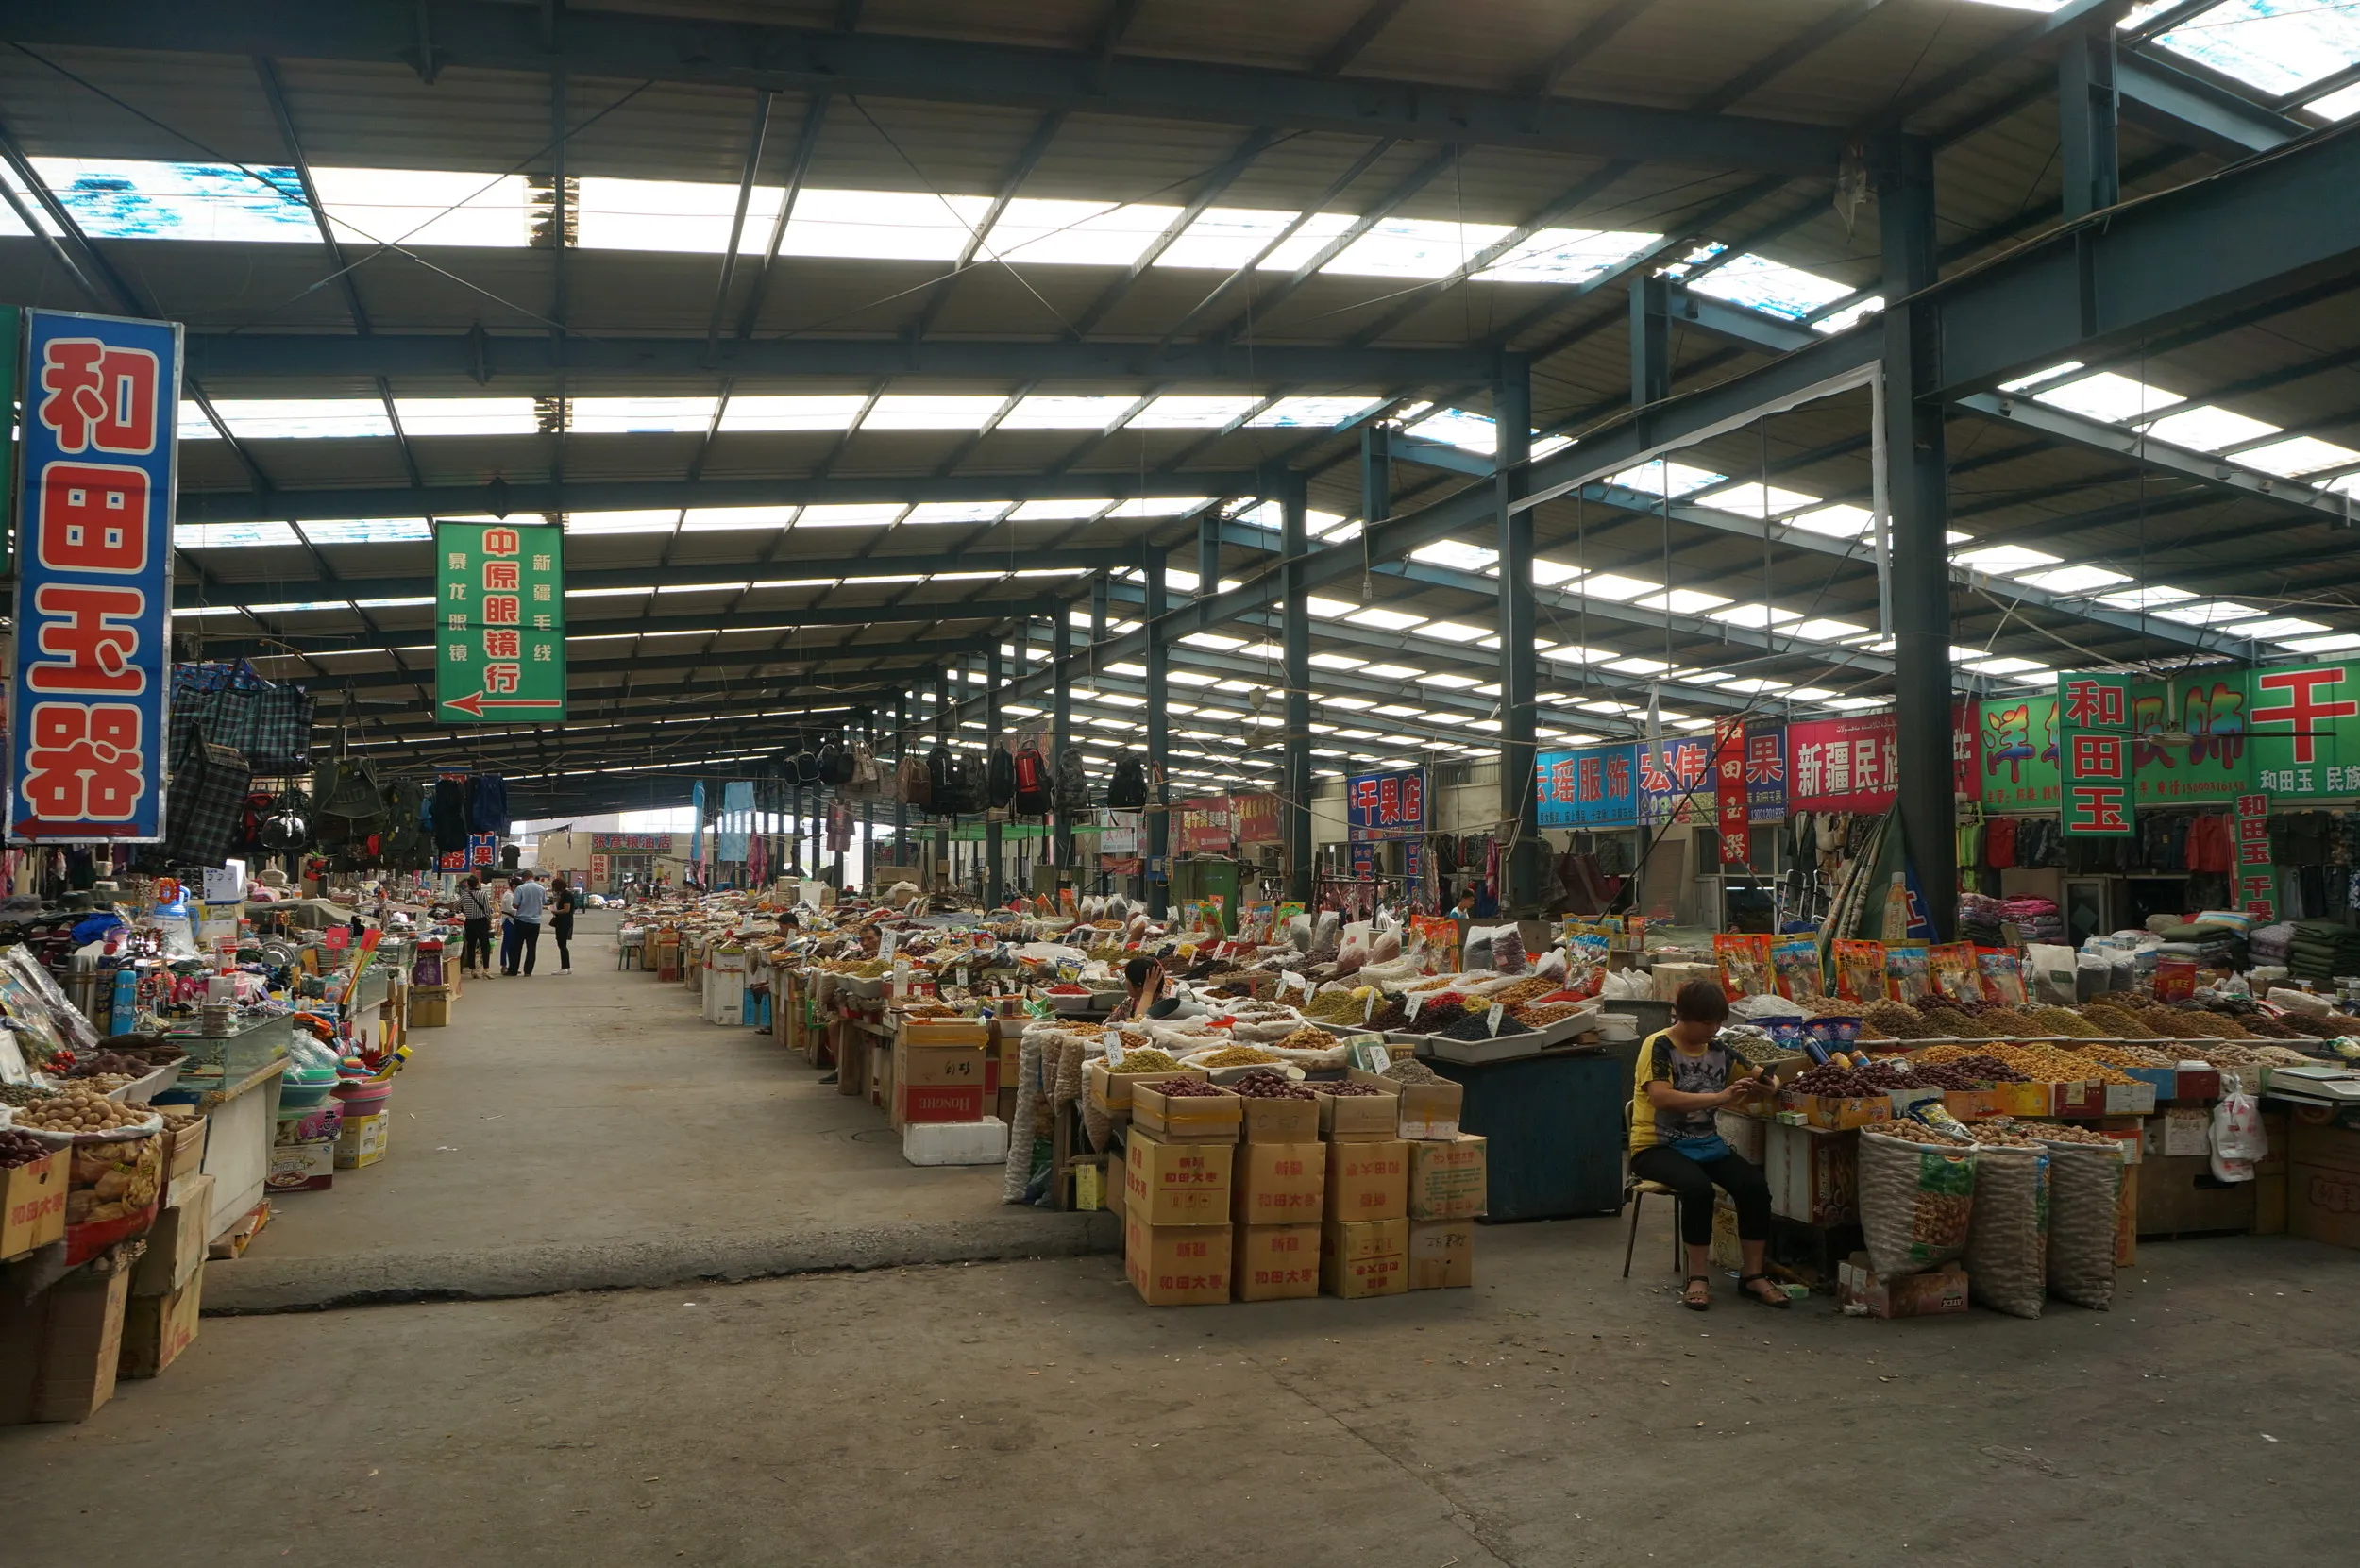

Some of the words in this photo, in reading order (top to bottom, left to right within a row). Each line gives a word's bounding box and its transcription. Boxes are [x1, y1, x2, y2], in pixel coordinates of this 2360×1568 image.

[21, 337, 160, 821] 和田玉器
[448, 552, 468, 661] 暴龙眼镜
[482, 527, 521, 693] 中原眼镜行
[533, 554, 551, 662] 新疆毛线
[1640, 734, 1784, 793] 宏伟果
[2065, 680, 2131, 833] 和田玉
[1716, 724, 1745, 861] 和田玉器
[2260, 769, 2315, 793] 和田玉
[1357, 774, 1422, 827] 干果店
[593, 835, 672, 850] 张彦粮油店
[2236, 794, 2271, 865] 和田玉
[2243, 875, 2275, 923] 干果
[919, 1096, 970, 1112] HONGHE
[1164, 1172, 1218, 1183] 和田大枣
[1274, 1160, 1303, 1176] 新疆
[11, 1191, 65, 1227] 和田大枣
[1257, 1192, 1316, 1207] 和田大枣
[1176, 1241, 1207, 1258] 新疆
[1271, 1236, 1299, 1253] 新疆
[1159, 1274, 1223, 1290] 和田大枣
[1254, 1268, 1313, 1285] 和田大枣
